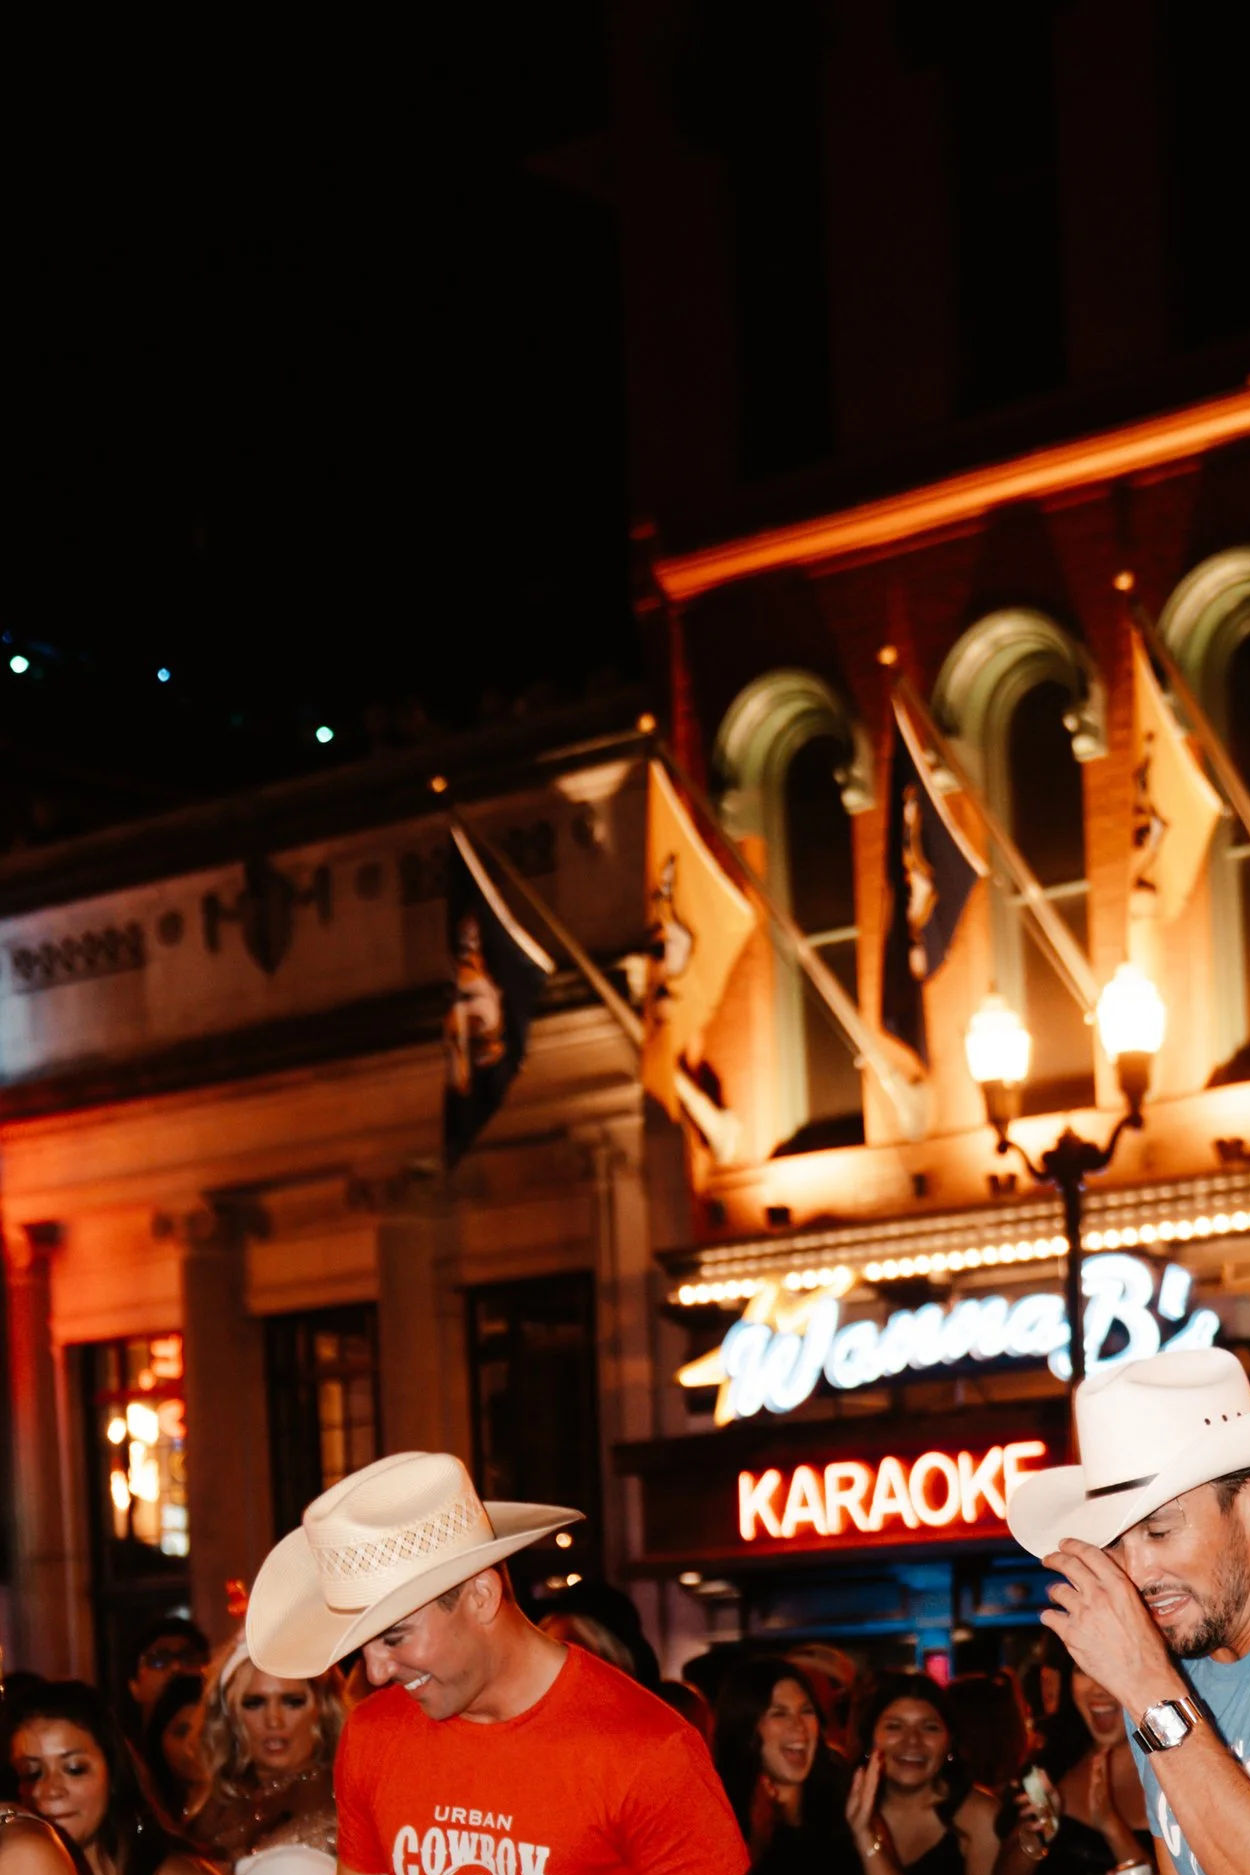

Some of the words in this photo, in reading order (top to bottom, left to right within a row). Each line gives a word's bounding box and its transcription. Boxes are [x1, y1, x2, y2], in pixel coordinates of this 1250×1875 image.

[720, 1294, 1073, 1418] Wanna
[738, 1440, 1046, 1541] KARAOKE
[433, 1804, 513, 1832] URBAN
